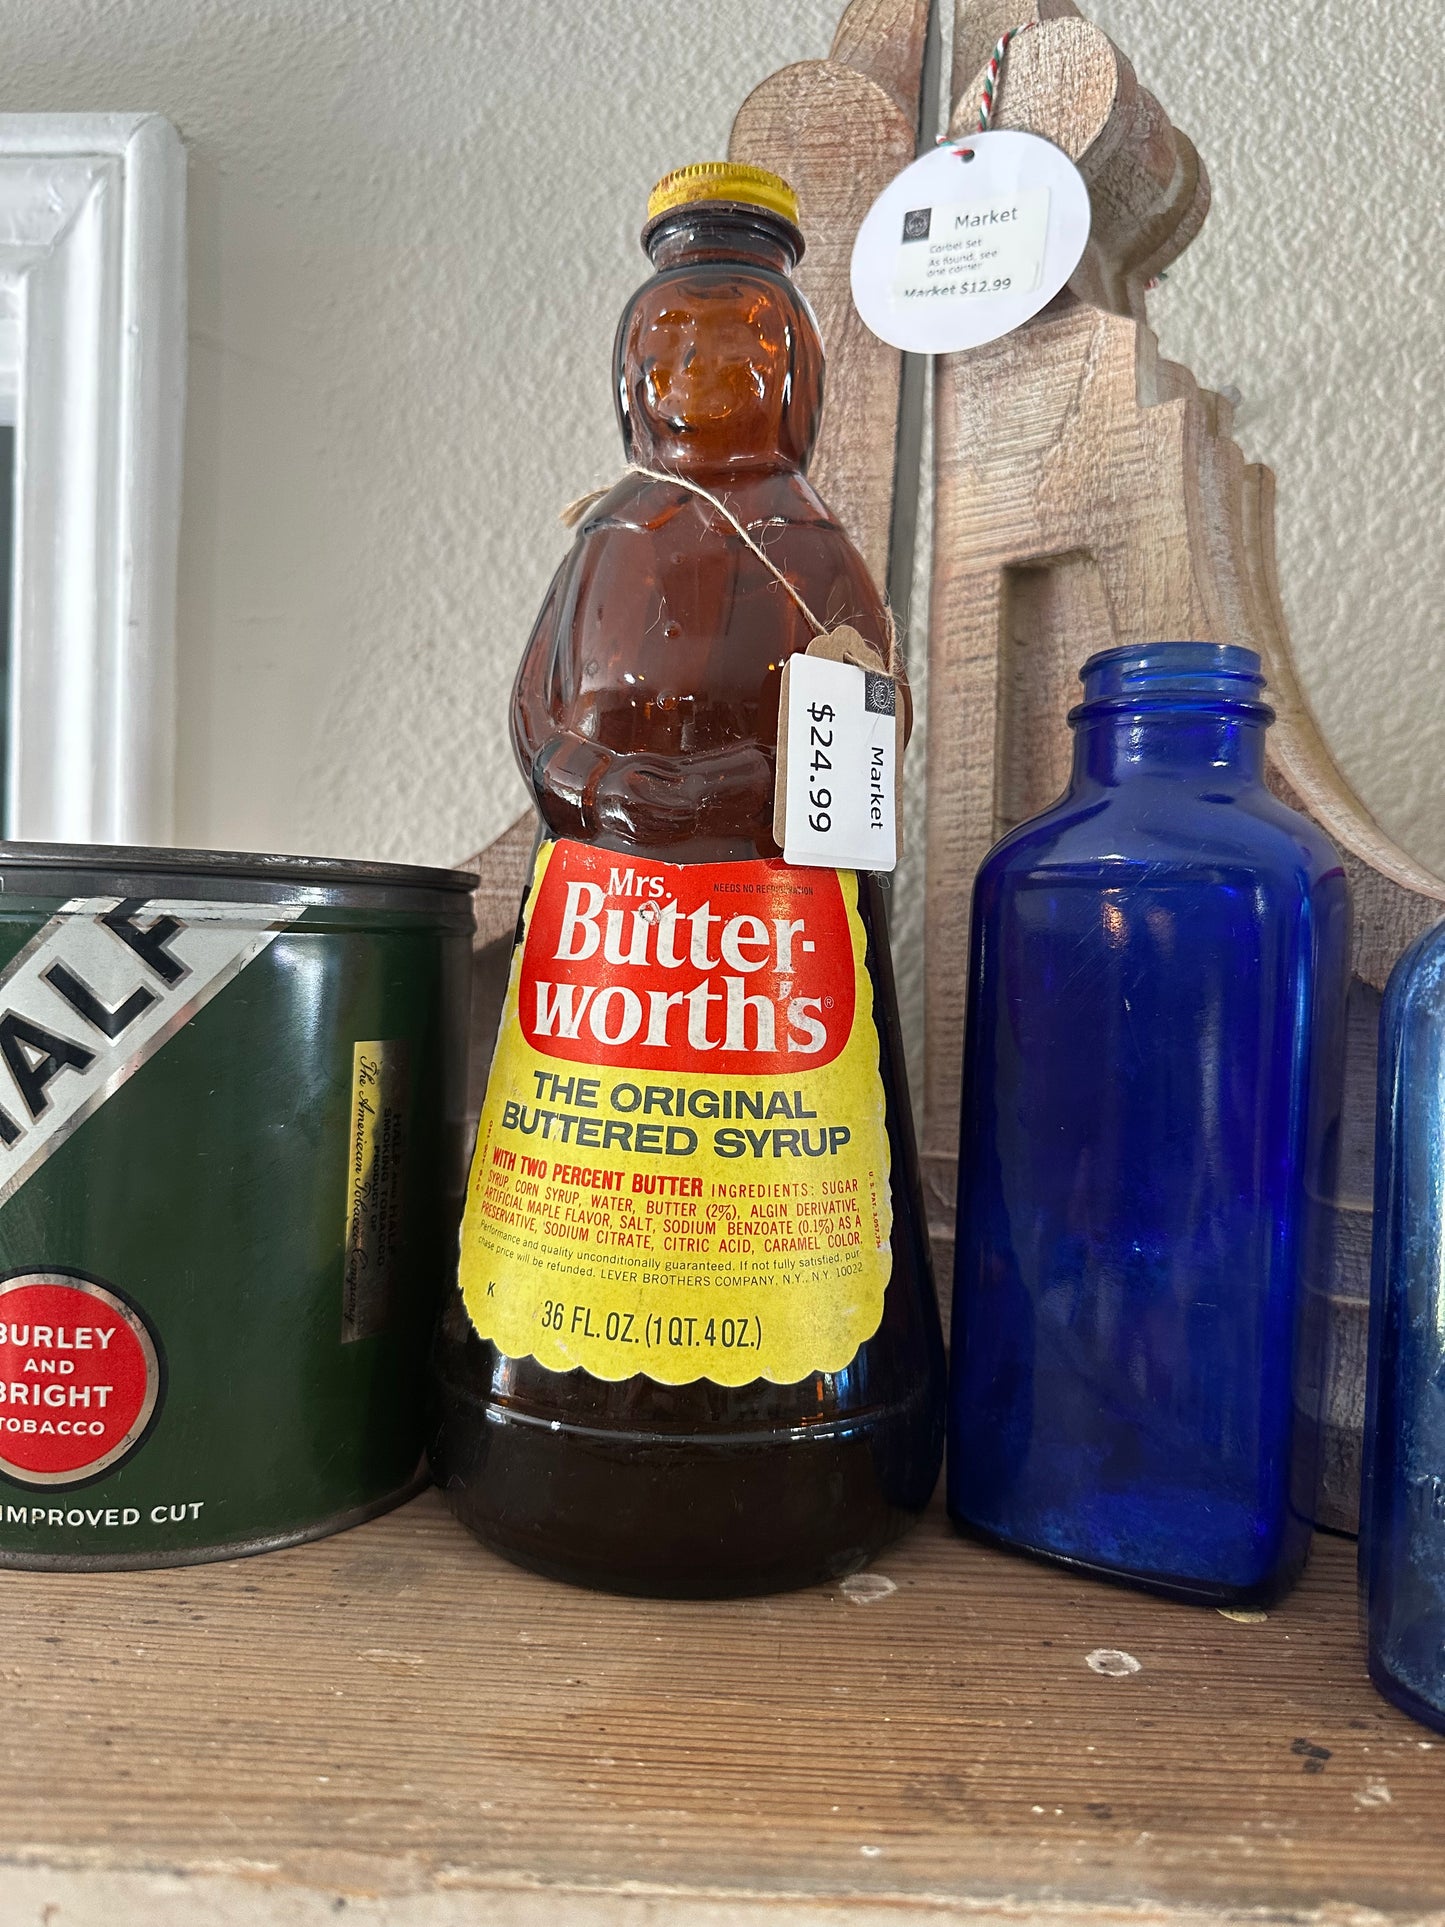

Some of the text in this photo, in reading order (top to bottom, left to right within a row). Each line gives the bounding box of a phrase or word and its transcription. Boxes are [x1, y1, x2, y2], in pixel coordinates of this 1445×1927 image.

[954, 207, 1018, 230] Market
[927, 267, 946, 277] one
[980, 250, 998, 260] see
[904, 277, 1012, 298] Market $12.99
[806, 702, 836, 833] $24.99
[870, 746, 885, 830] Market
[608, 867, 673, 899] Mrs.
[713, 883, 741, 893] NEEDS
[743, 883, 754, 893] NO
[552, 880, 815, 974] Butter-
[0, 899, 192, 1150] ALF
[532, 975, 828, 1054] worth's
[533, 1070, 817, 1119] THE ORIGINAL
[502, 1101, 851, 1159] BUTTERED SYRUP
[344, 1056, 378, 1328] The American Tobacco Company
[371, 1146, 381, 1209] PRODUCT
[377, 1107, 392, 1267] SMOKING TOBACCO
[488, 1169, 860, 1221] SYRUP, CORN SYRUP, WATER, BUTTER (2%), ALGIN DERIVATIVE,
[492, 1146, 858, 1198] WITH TWO PERCENT BUTTER INGREDIENTS: SUGAR
[480, 1201, 863, 1255] PRESERVATIVE, SODIUM CITRATE, CITRIC ACID, CARAMEL COLOR.
[484, 1184, 862, 1236] ARTIFICIAL MAPLE FLAVOR, SALT, SODIUM BENZOATE (0.1%) AS A
[478, 1235, 495, 1251] chase
[495, 1245, 514, 1260] price
[516, 1252, 530, 1264] will
[532, 1257, 544, 1268] be
[546, 1261, 596, 1278] refunded.
[601, 1269, 638, 1283] LEVER
[643, 1273, 711, 1287] BROTHERS
[836, 1262, 863, 1277] 10022
[480, 1219, 521, 1245] Performance
[522, 1238, 539, 1250] and
[541, 1243, 573, 1260] quality
[577, 1250, 661, 1270] unconditionally
[664, 1260, 736, 1272] guaranteed.
[740, 1260, 749, 1270] If
[752, 1259, 770, 1270] not
[773, 1258, 796, 1271] fully
[487, 1280, 496, 1297] K
[541, 1300, 564, 1331] 36
[24, 1358, 75, 1375] AND
[150, 1501, 205, 1523] CUT
